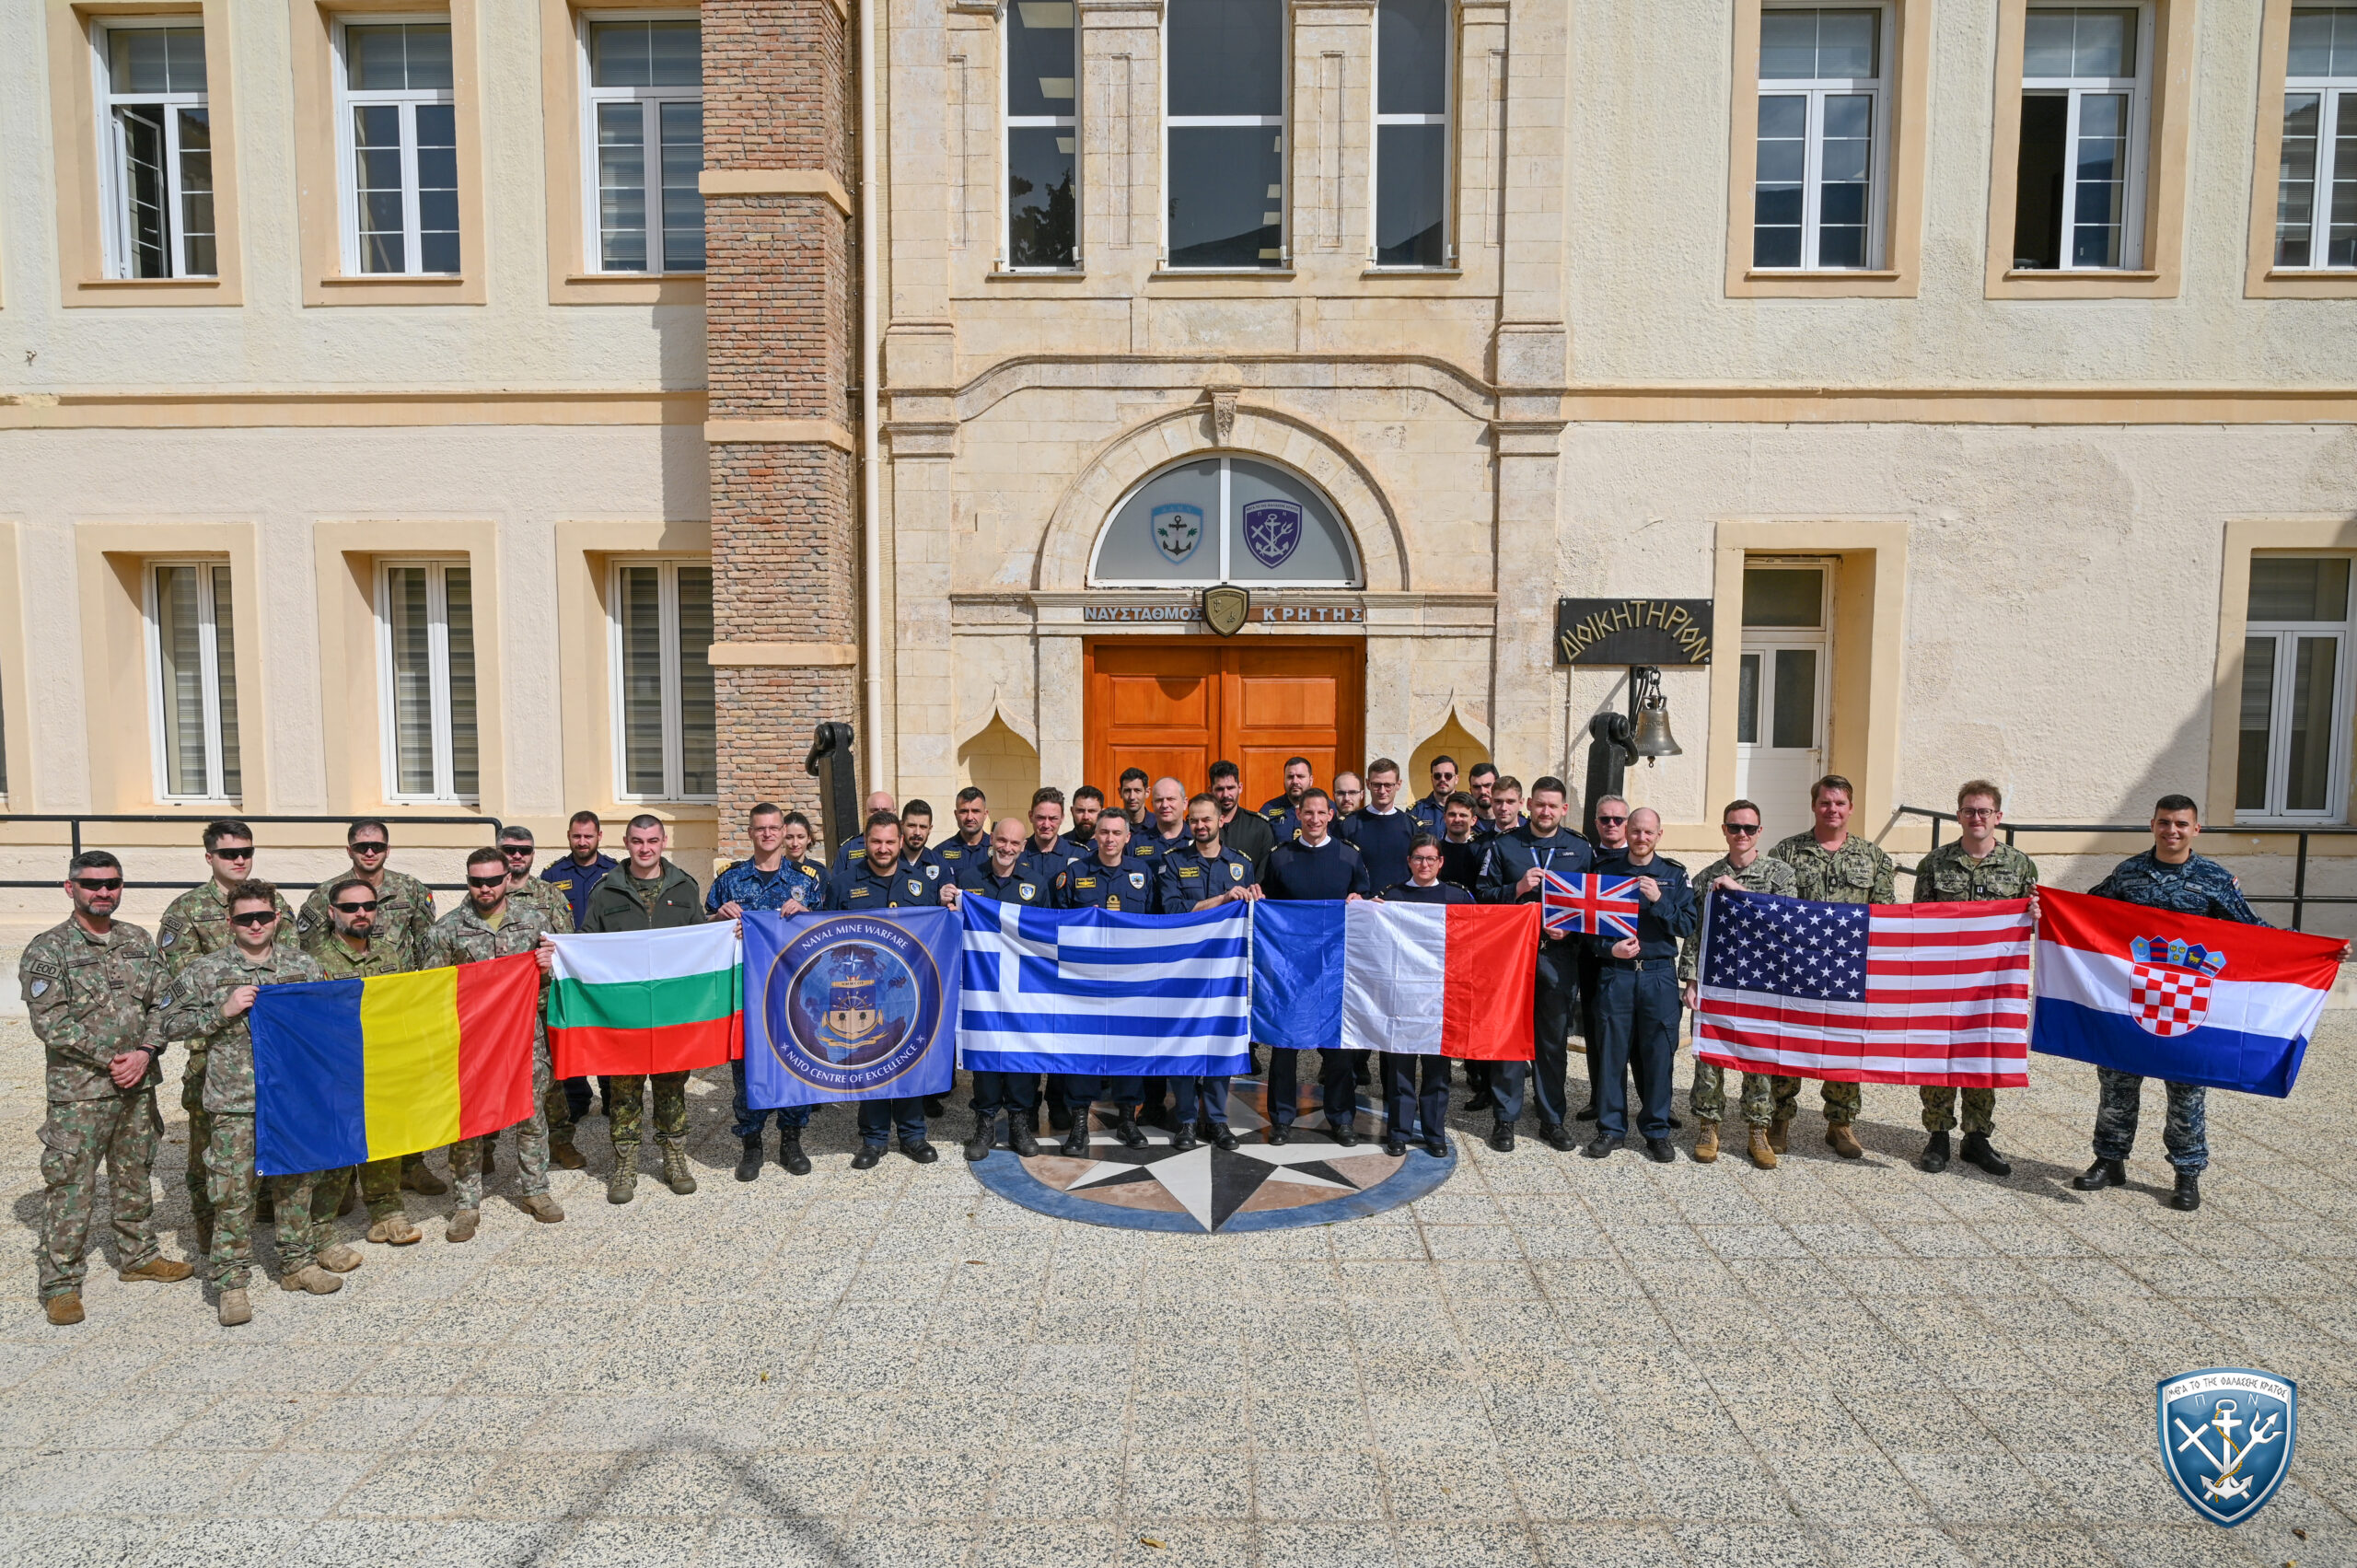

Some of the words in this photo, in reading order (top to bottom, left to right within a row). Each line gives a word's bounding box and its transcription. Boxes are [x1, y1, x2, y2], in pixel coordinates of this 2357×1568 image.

[1085, 606, 1202, 621] ΝΑΥΣΤΑΘΜΟΣ
[1263, 608, 1363, 621] ΚΡΗΤΗΣ
[1561, 599, 1711, 663] ΔΙΟΙΚΗΤΗΡΙΟΝ
[168, 919, 180, 928] EOD
[801, 929, 834, 950] NAVAL
[836, 923, 863, 935] MINE
[865, 924, 909, 949] WARFARE
[36, 963, 57, 975] EOD
[786, 1051, 809, 1072] NATO
[810, 1067, 846, 1083] CENTRE
[849, 1074, 864, 1083] OF
[865, 1043, 918, 1081] EXCELLENCE
